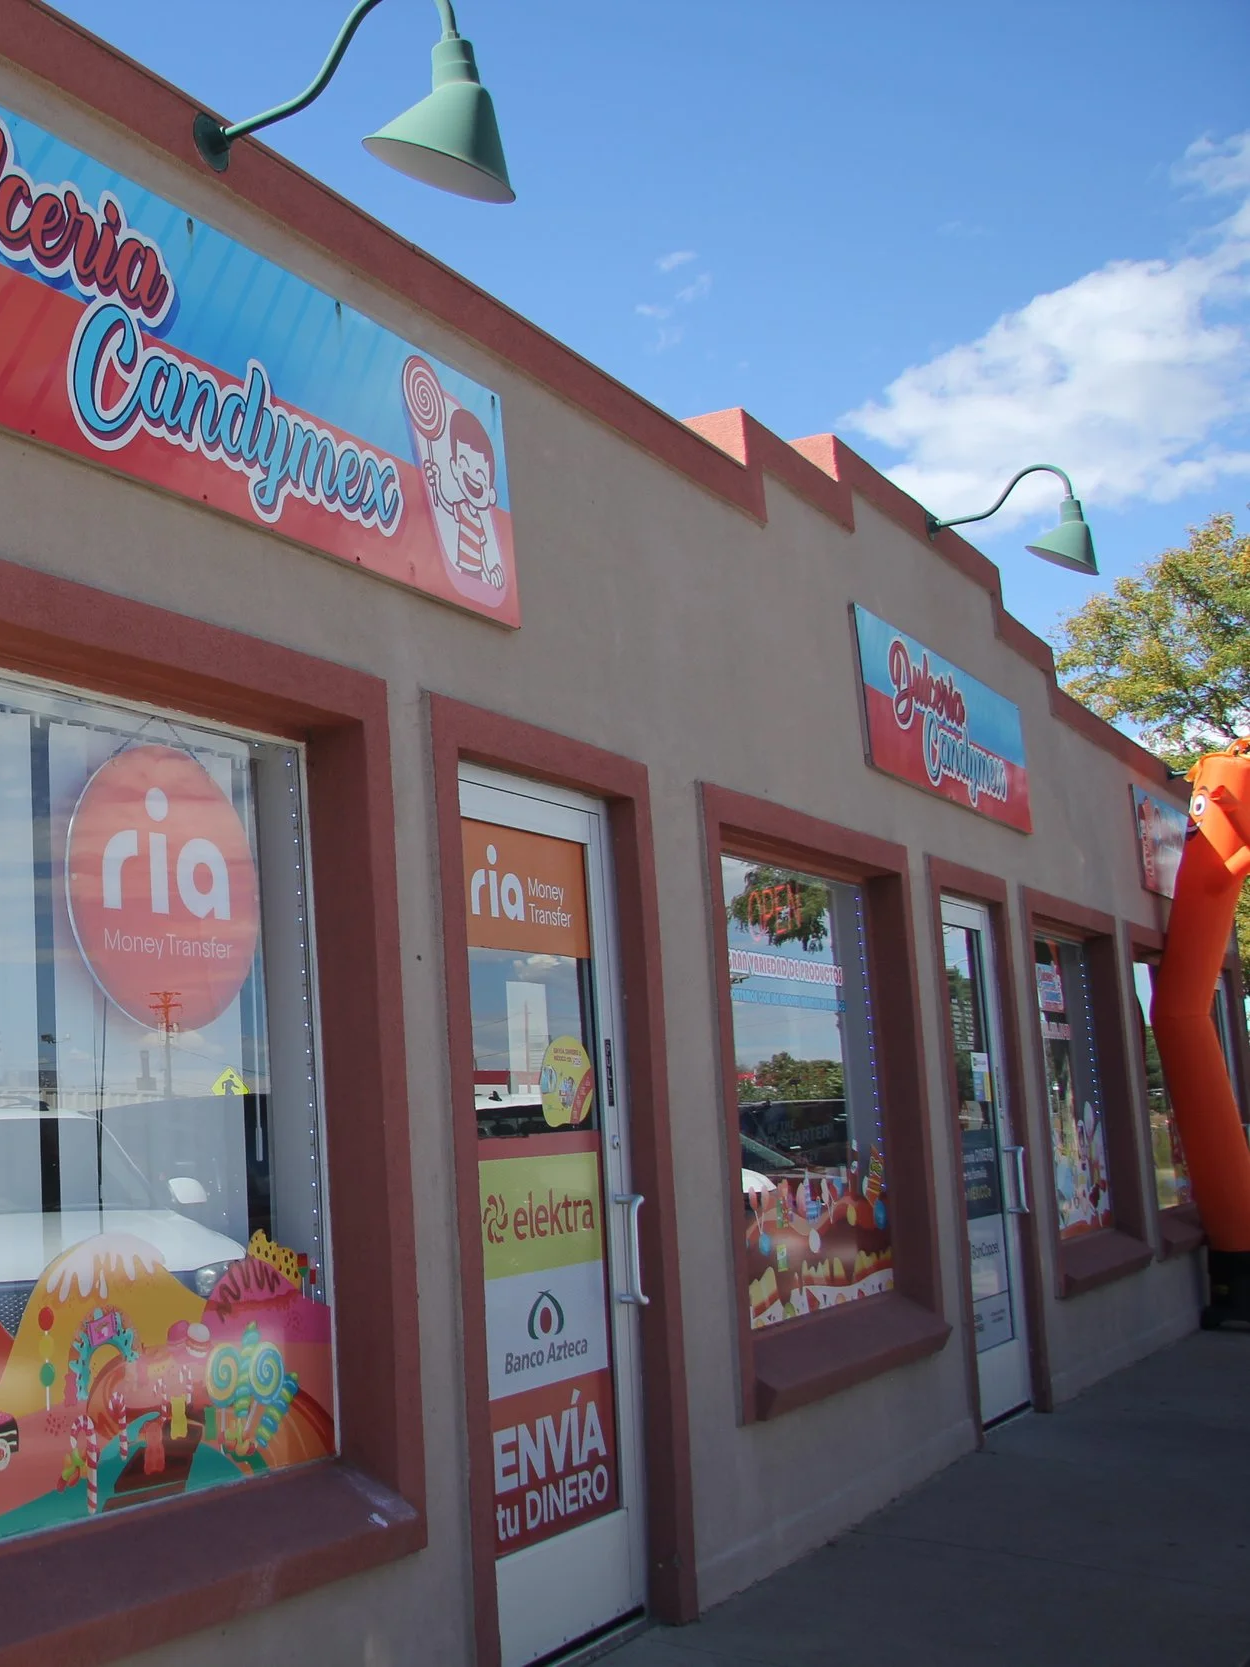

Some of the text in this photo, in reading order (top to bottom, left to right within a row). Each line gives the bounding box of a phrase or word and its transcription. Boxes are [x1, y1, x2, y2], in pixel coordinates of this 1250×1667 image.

[70, 303, 403, 533] Candymex
[889, 638, 966, 728] Dulceria
[923, 710, 1007, 806] Candymex
[102, 787, 230, 920] ria
[470, 844, 525, 921] ria
[527, 877, 564, 905] Money
[104, 928, 232, 959] Money Transfer
[528, 903, 572, 928] Transfer
[747, 883, 802, 942] OPEN
[513, 1188, 595, 1241] elektra
[505, 1338, 588, 1375] Banco Azteca
[493, 1389, 607, 1494] ENVÍA
[496, 1464, 608, 1541] tu DINERO
